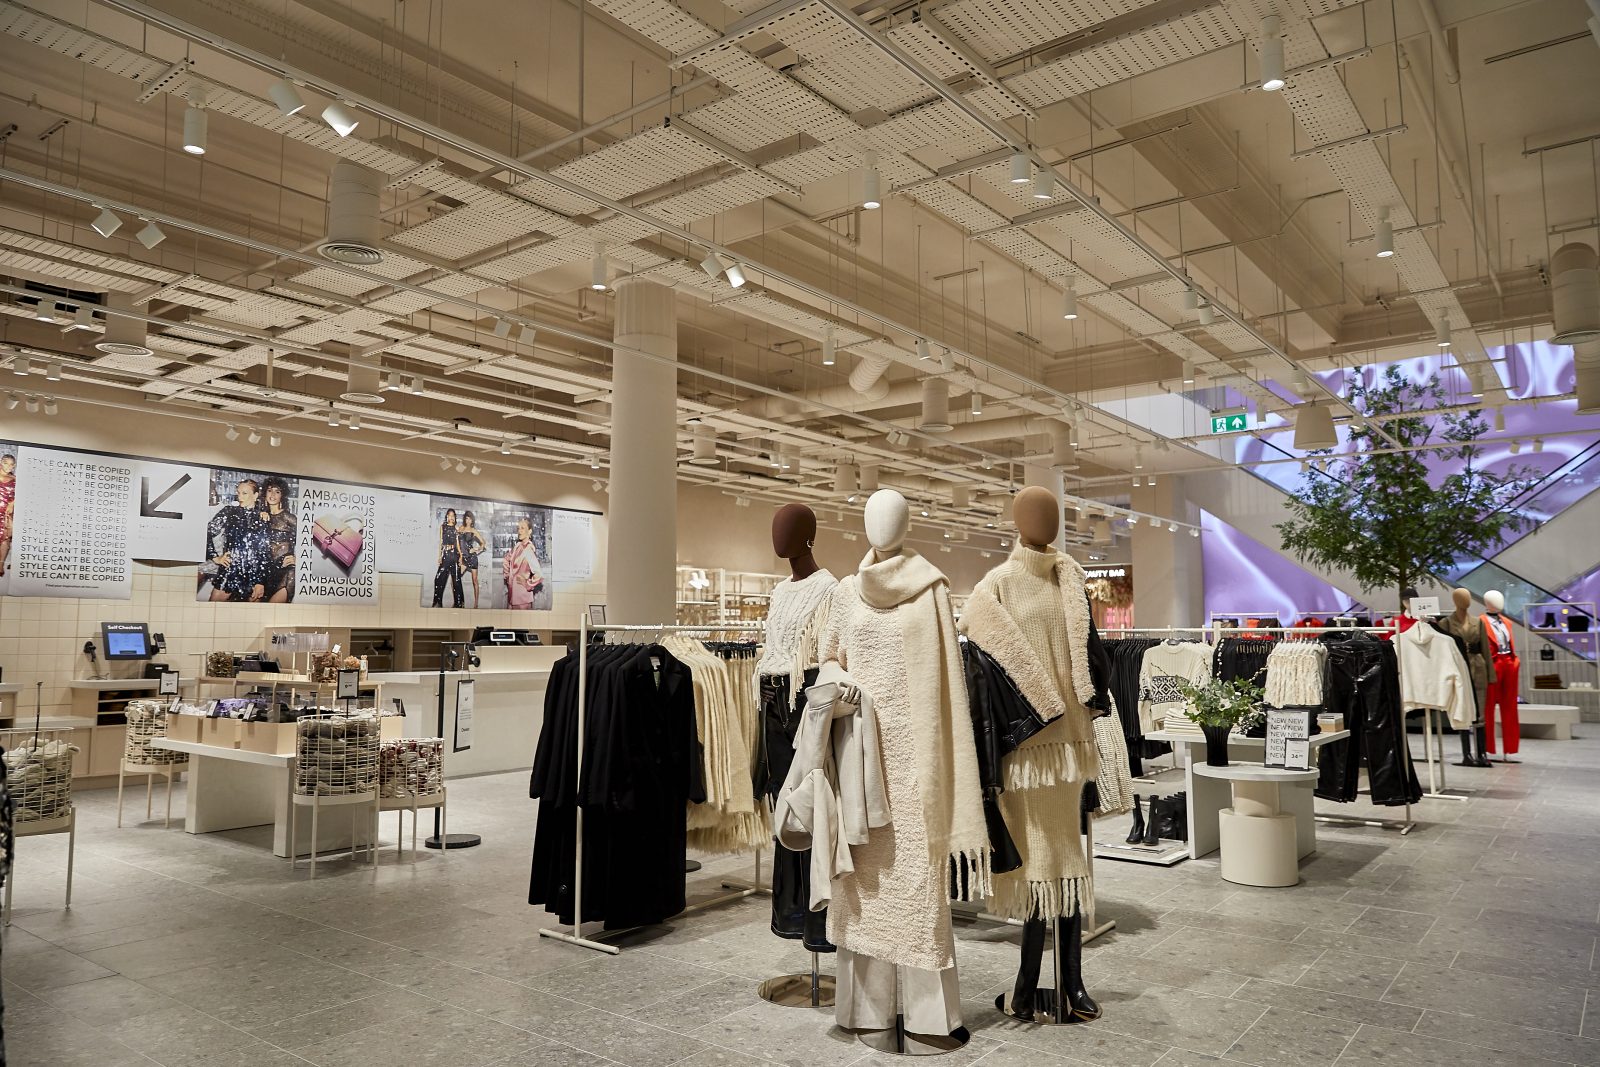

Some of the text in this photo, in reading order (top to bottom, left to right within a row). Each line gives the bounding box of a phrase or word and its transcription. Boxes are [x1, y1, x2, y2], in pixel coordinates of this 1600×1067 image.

[57, 461, 84, 470] CAN'T
[99, 466, 130, 475] COPIED
[98, 474, 129, 484] COPIED
[98, 482, 129, 491] COPIED
[97, 491, 128, 499] COPIED
[303, 489, 375, 506] AMBAGIOUS
[94, 541, 126, 549] COPIED
[93, 557, 125, 565] COPIED
[299, 586, 372, 597] AMBAGIOUS
